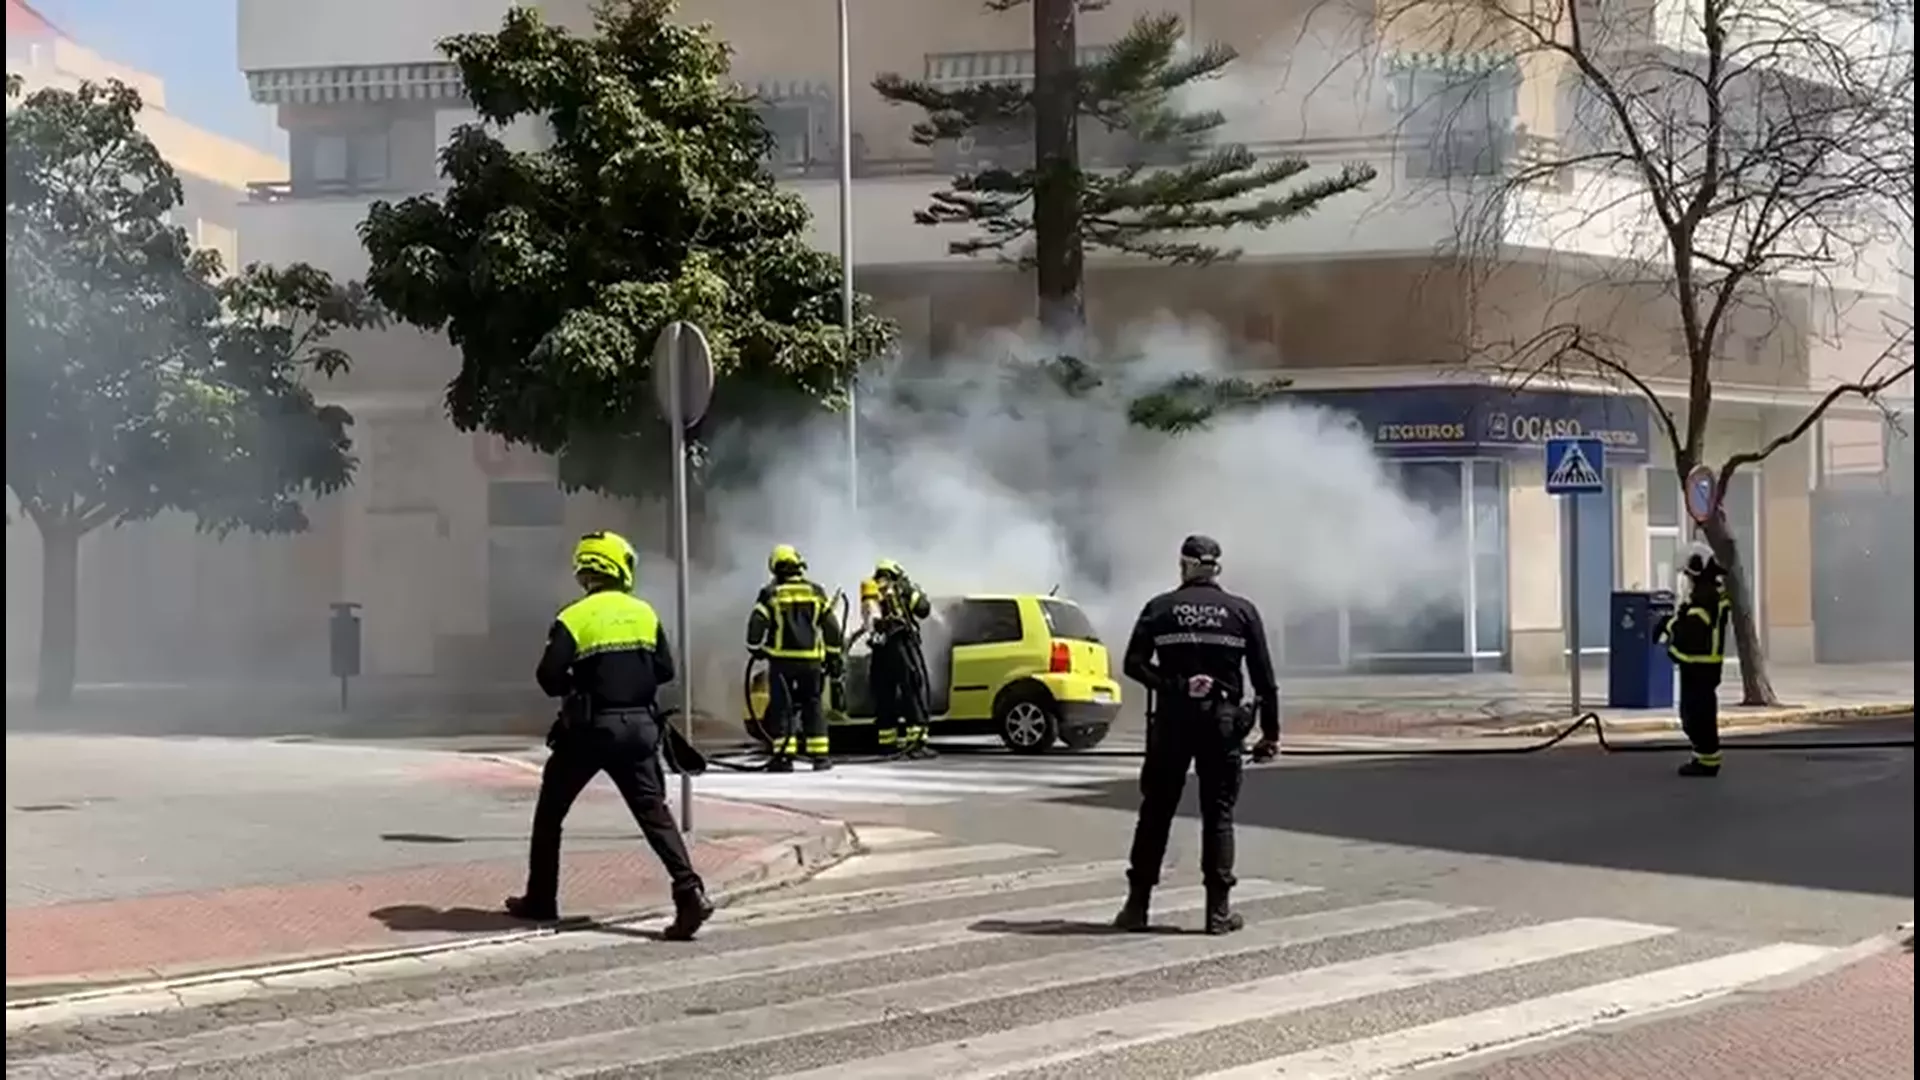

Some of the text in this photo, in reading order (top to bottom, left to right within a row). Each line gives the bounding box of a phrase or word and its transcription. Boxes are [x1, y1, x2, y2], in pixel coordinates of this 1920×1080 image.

[1378, 423, 1465, 440] SEGUROS
[1512, 415, 1582, 441] OCASO
[1177, 615, 1223, 628] LOCAL
